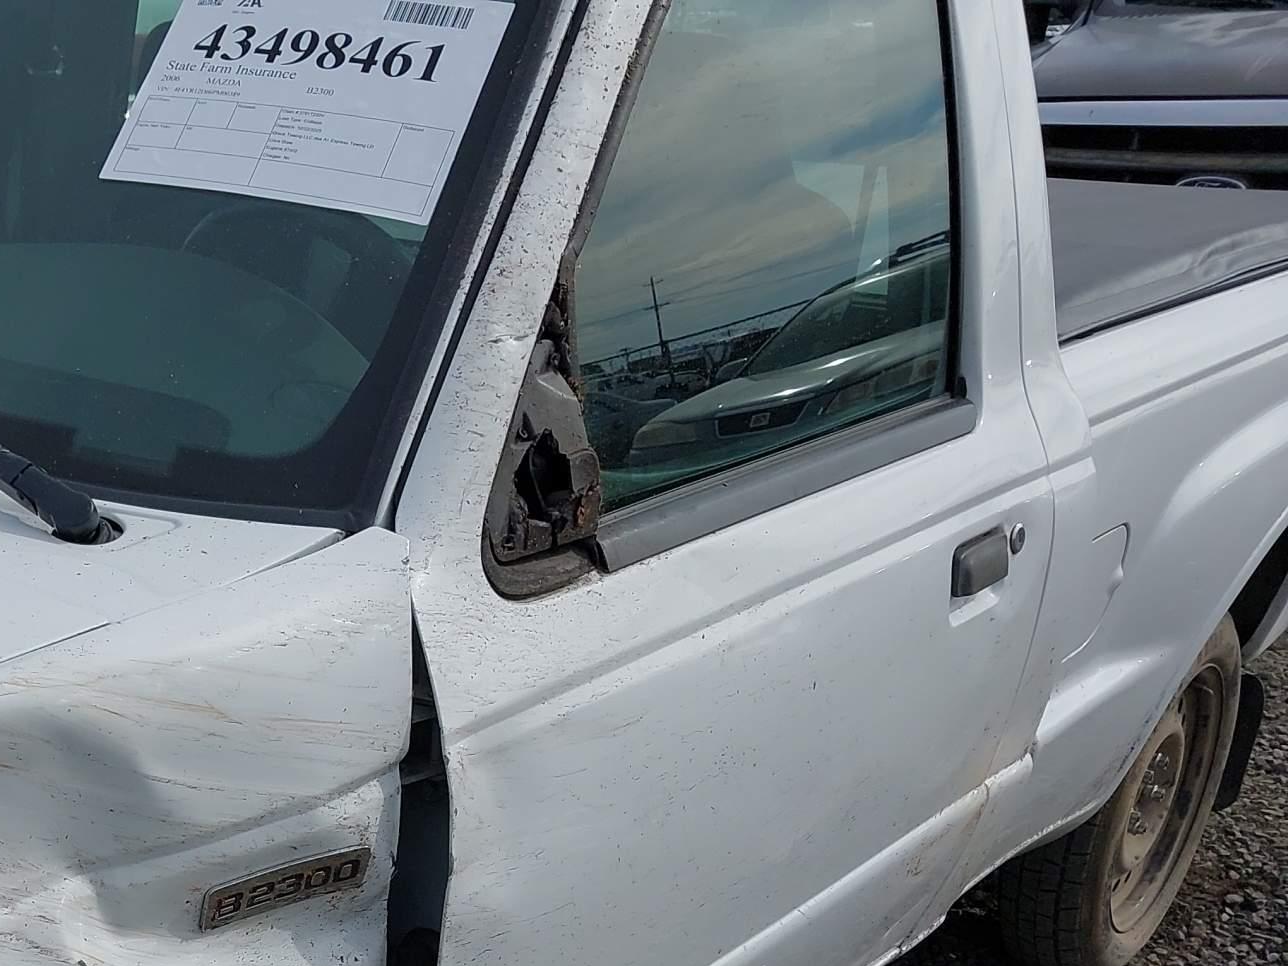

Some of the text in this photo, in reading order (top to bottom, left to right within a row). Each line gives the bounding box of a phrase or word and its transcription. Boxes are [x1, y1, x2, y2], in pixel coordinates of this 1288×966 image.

[165, 60, 298, 80] State Farm Insurance
[193, 23, 447, 83] 43498461
[205, 77, 242, 87] MAZDA
[211, 859, 362, 922] B2300
